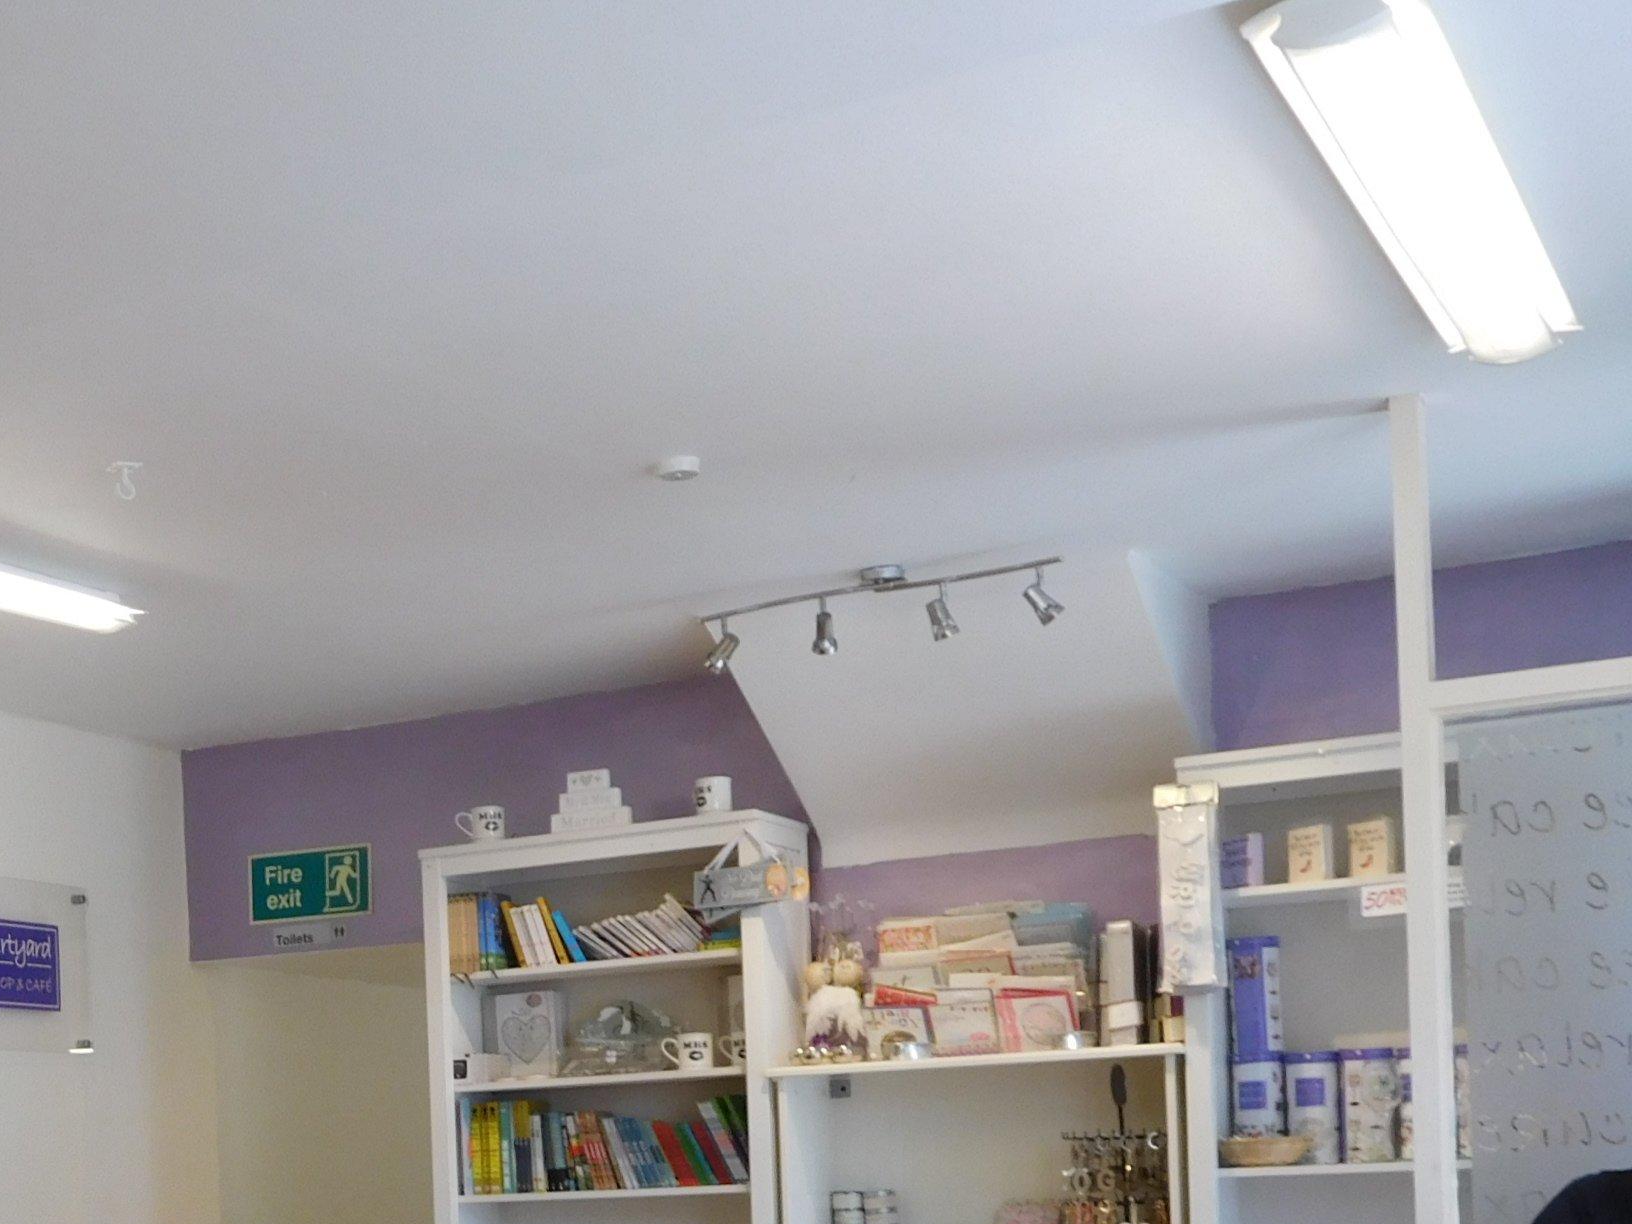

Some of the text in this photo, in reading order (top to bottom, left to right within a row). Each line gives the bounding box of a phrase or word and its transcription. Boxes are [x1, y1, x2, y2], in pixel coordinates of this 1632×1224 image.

[264, 865, 303, 886] Fire
[266, 888, 302, 910] exit
[276, 932, 314, 946] Toilets
